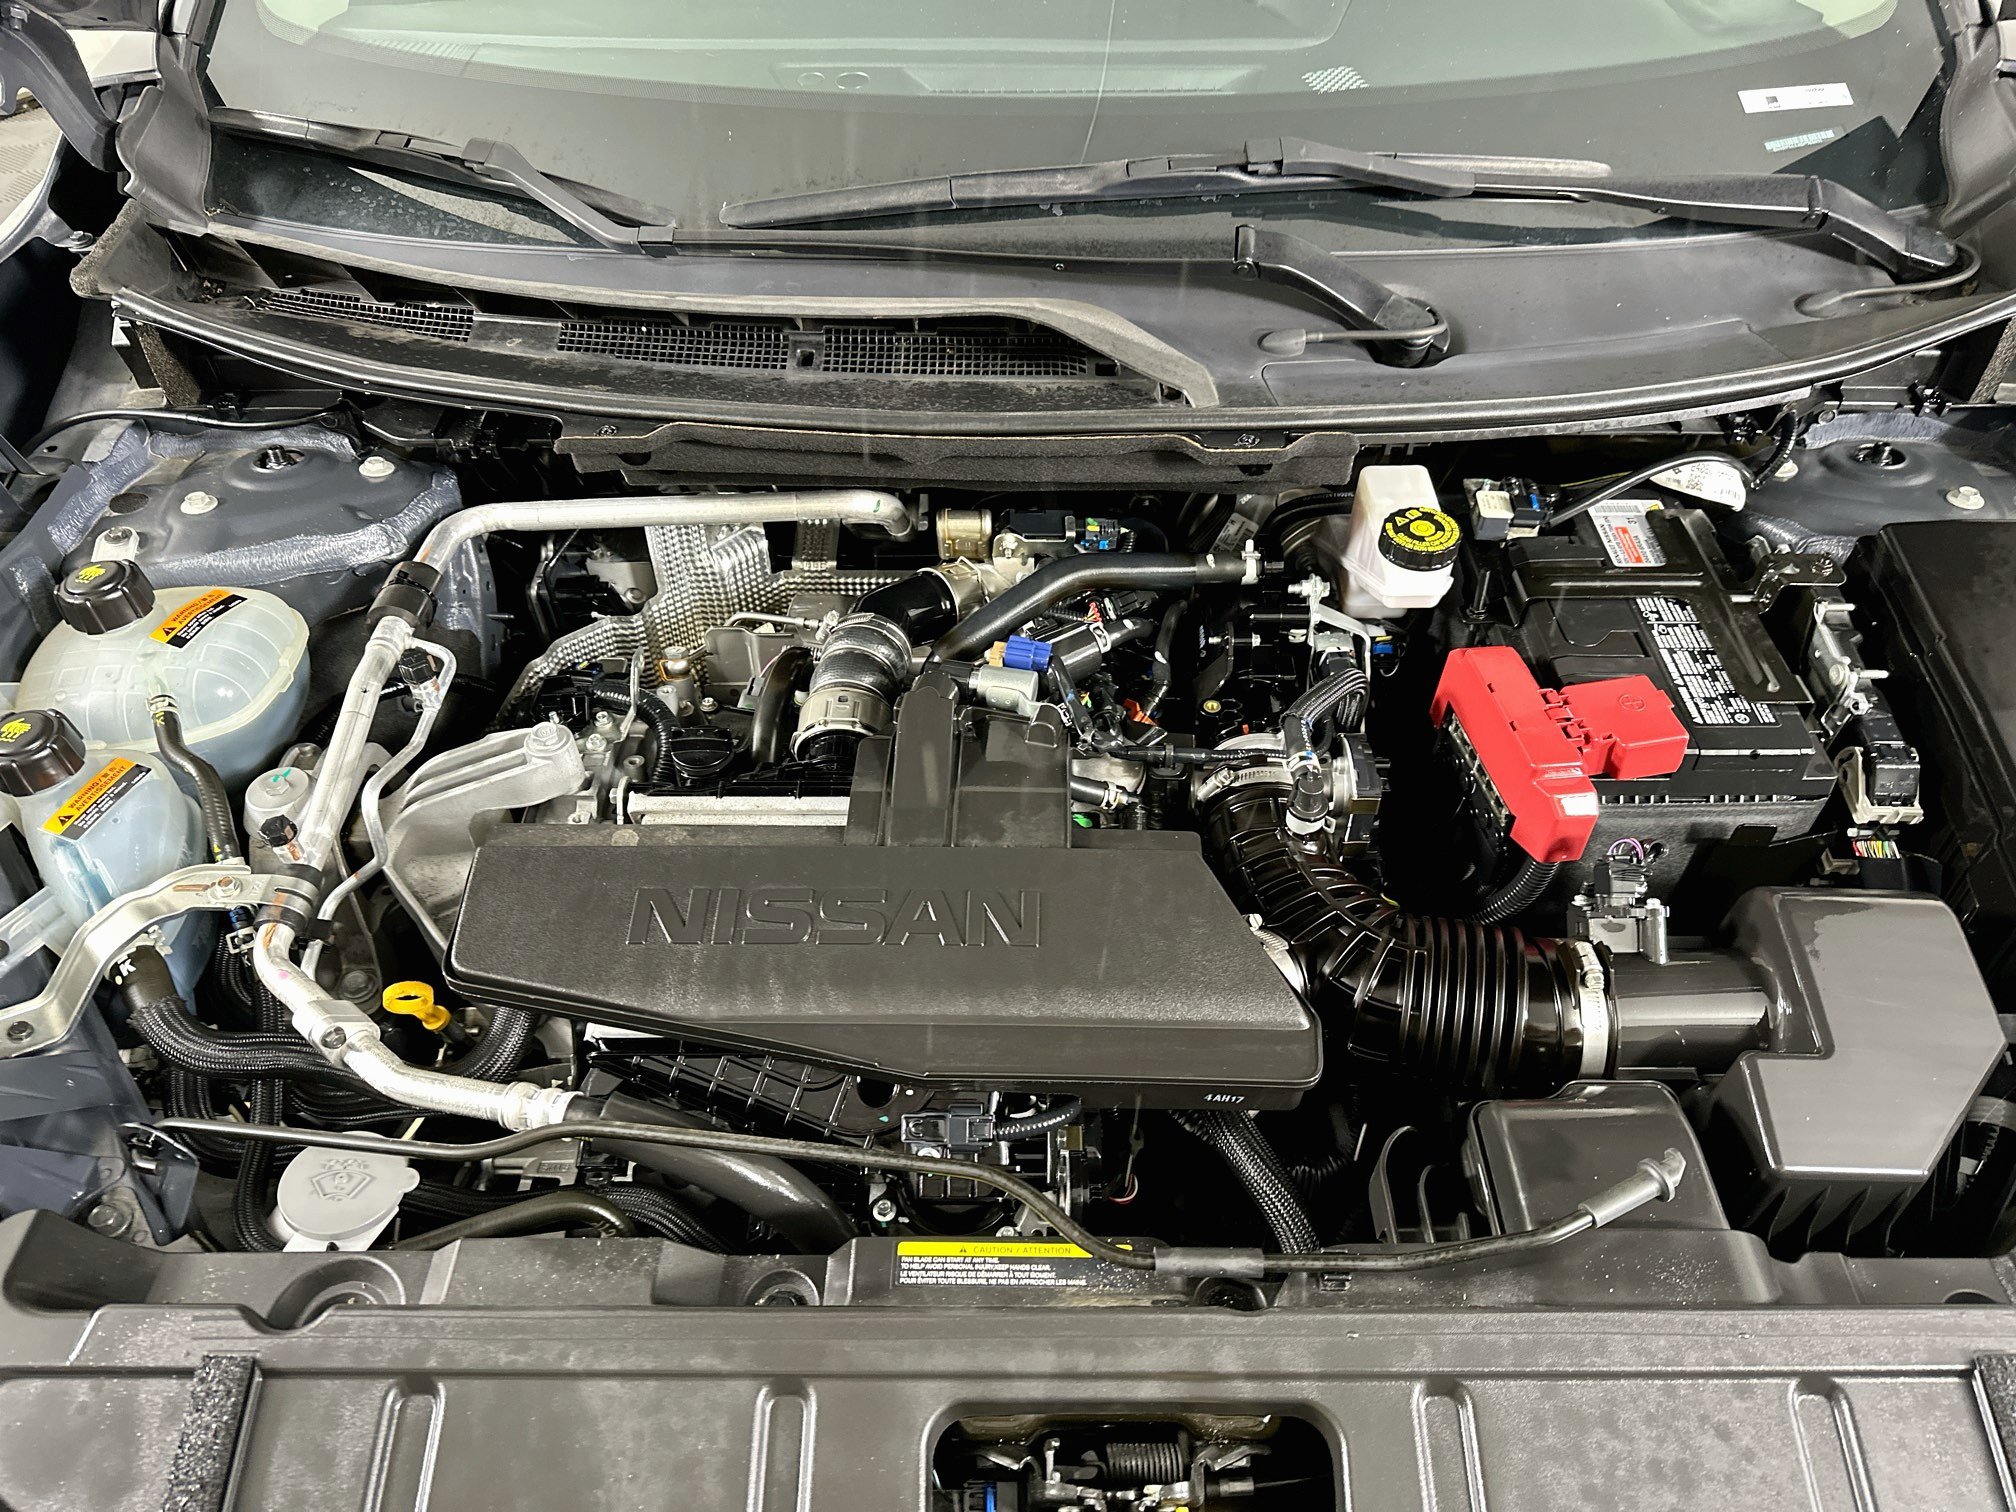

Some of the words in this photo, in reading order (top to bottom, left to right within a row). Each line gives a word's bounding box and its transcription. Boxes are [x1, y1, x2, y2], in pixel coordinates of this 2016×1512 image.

[68, 781, 100, 809] WARNING
[76, 765, 126, 812] AVERTISSEMENT
[625, 886, 1041, 947] NISSAN
[1203, 1093, 1245, 1104] 4AH17
[1022, 1247, 1071, 1255] ATTENTION
